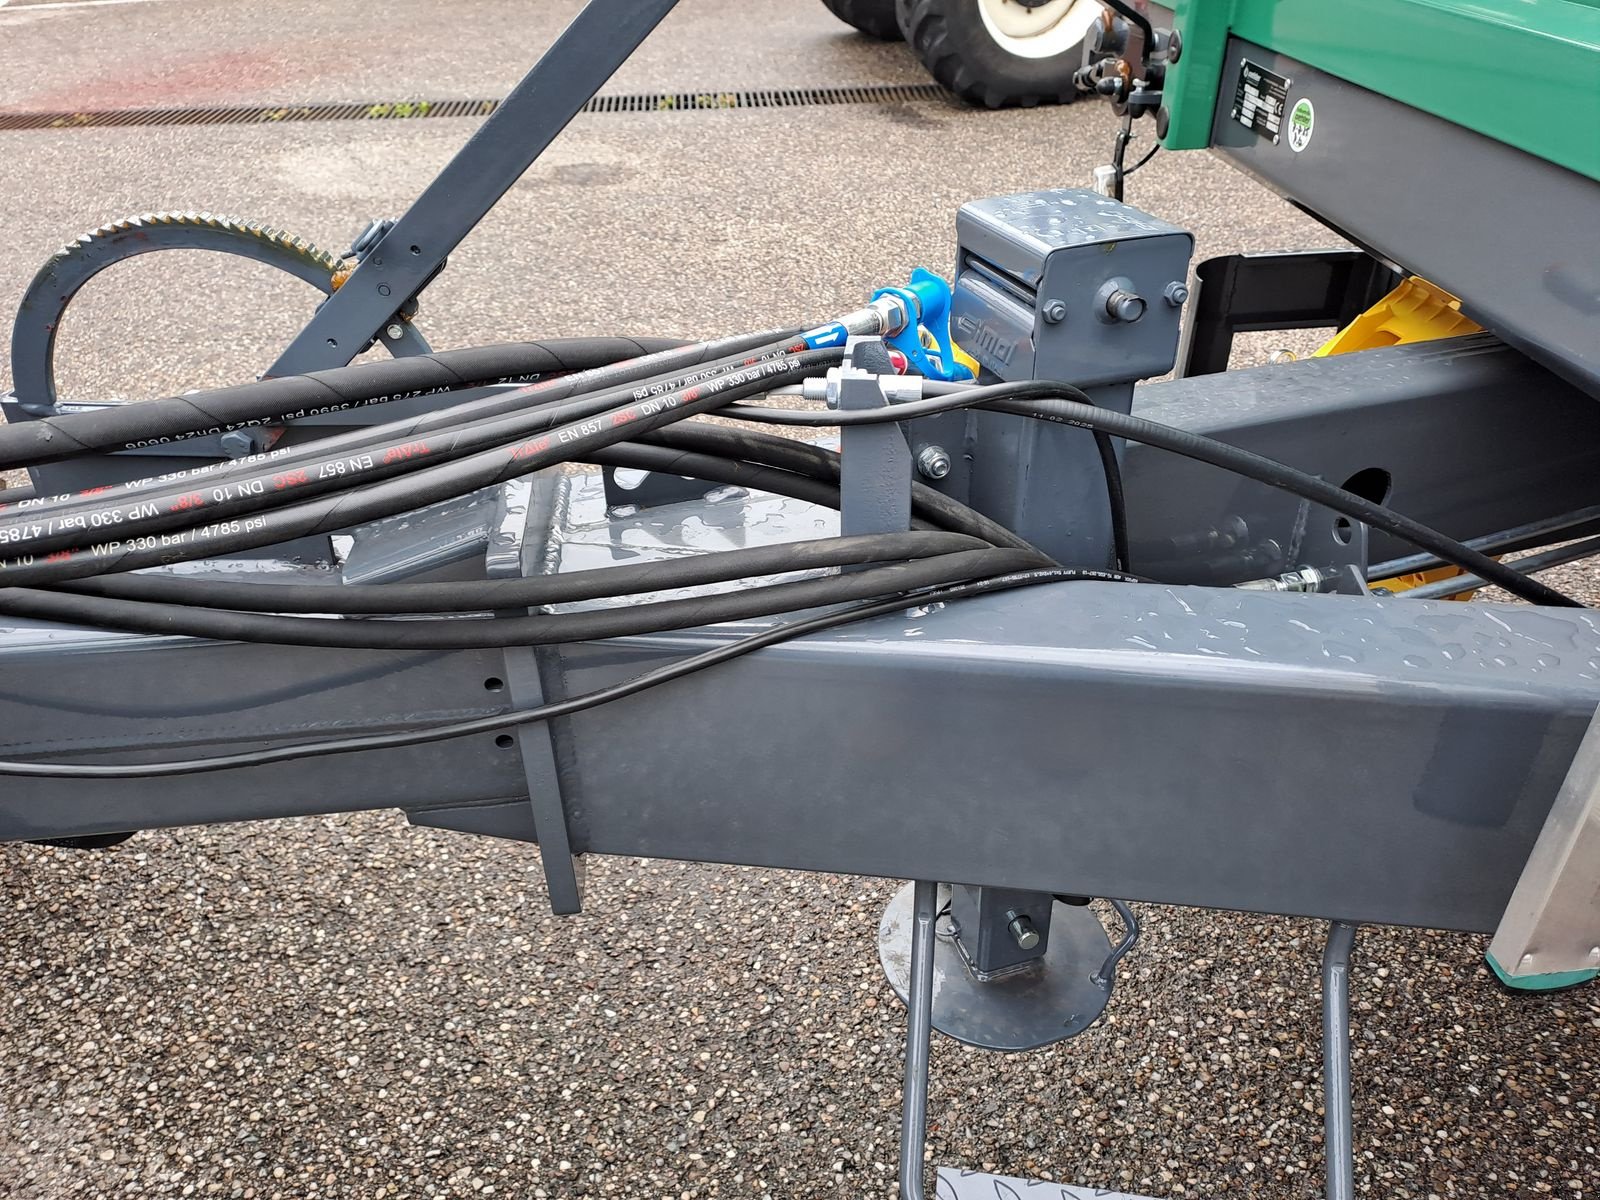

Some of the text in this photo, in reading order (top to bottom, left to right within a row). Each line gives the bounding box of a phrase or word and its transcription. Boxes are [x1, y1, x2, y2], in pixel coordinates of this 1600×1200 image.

[518, 372, 541, 382] DN
[558, 429, 580, 444] EN
[581, 419, 603, 436] 857
[610, 411, 637, 427] 2SC
[640, 403, 661, 417] DN
[662, 396, 677, 408] 10
[706, 380, 725, 394] WP
[727, 374, 745, 388] 330
[746, 368, 761, 382] bar
[767, 360, 788, 374] 4785
[788, 358, 801, 369] psi
[632, 386, 649, 402] psi
[280, 408, 305, 422] psi
[310, 402, 350, 416] 3990
[318, 460, 346, 479] 857
[348, 454, 373, 472] EN
[18, 497, 46, 509] DN
[50, 493, 71, 504] 10
[124, 477, 154, 490] WP
[158, 470, 188, 482] 330
[191, 463, 216, 476] bar
[229, 453, 267, 467] 4785
[270, 446, 291, 461] psi
[271, 469, 310, 490] 2SC
[212, 486, 233, 502] 10
[237, 479, 264, 498] DN
[90, 509, 123, 527] 330
[127, 502, 159, 520] WP
[58, 515, 86, 531] bar
[0, 524, 42, 544] 4785
[90, 541, 122, 557] WP
[126, 535, 157, 552] 330
[161, 531, 187, 547] bar
[200, 520, 241, 538] 4785
[245, 515, 268, 533] psi
